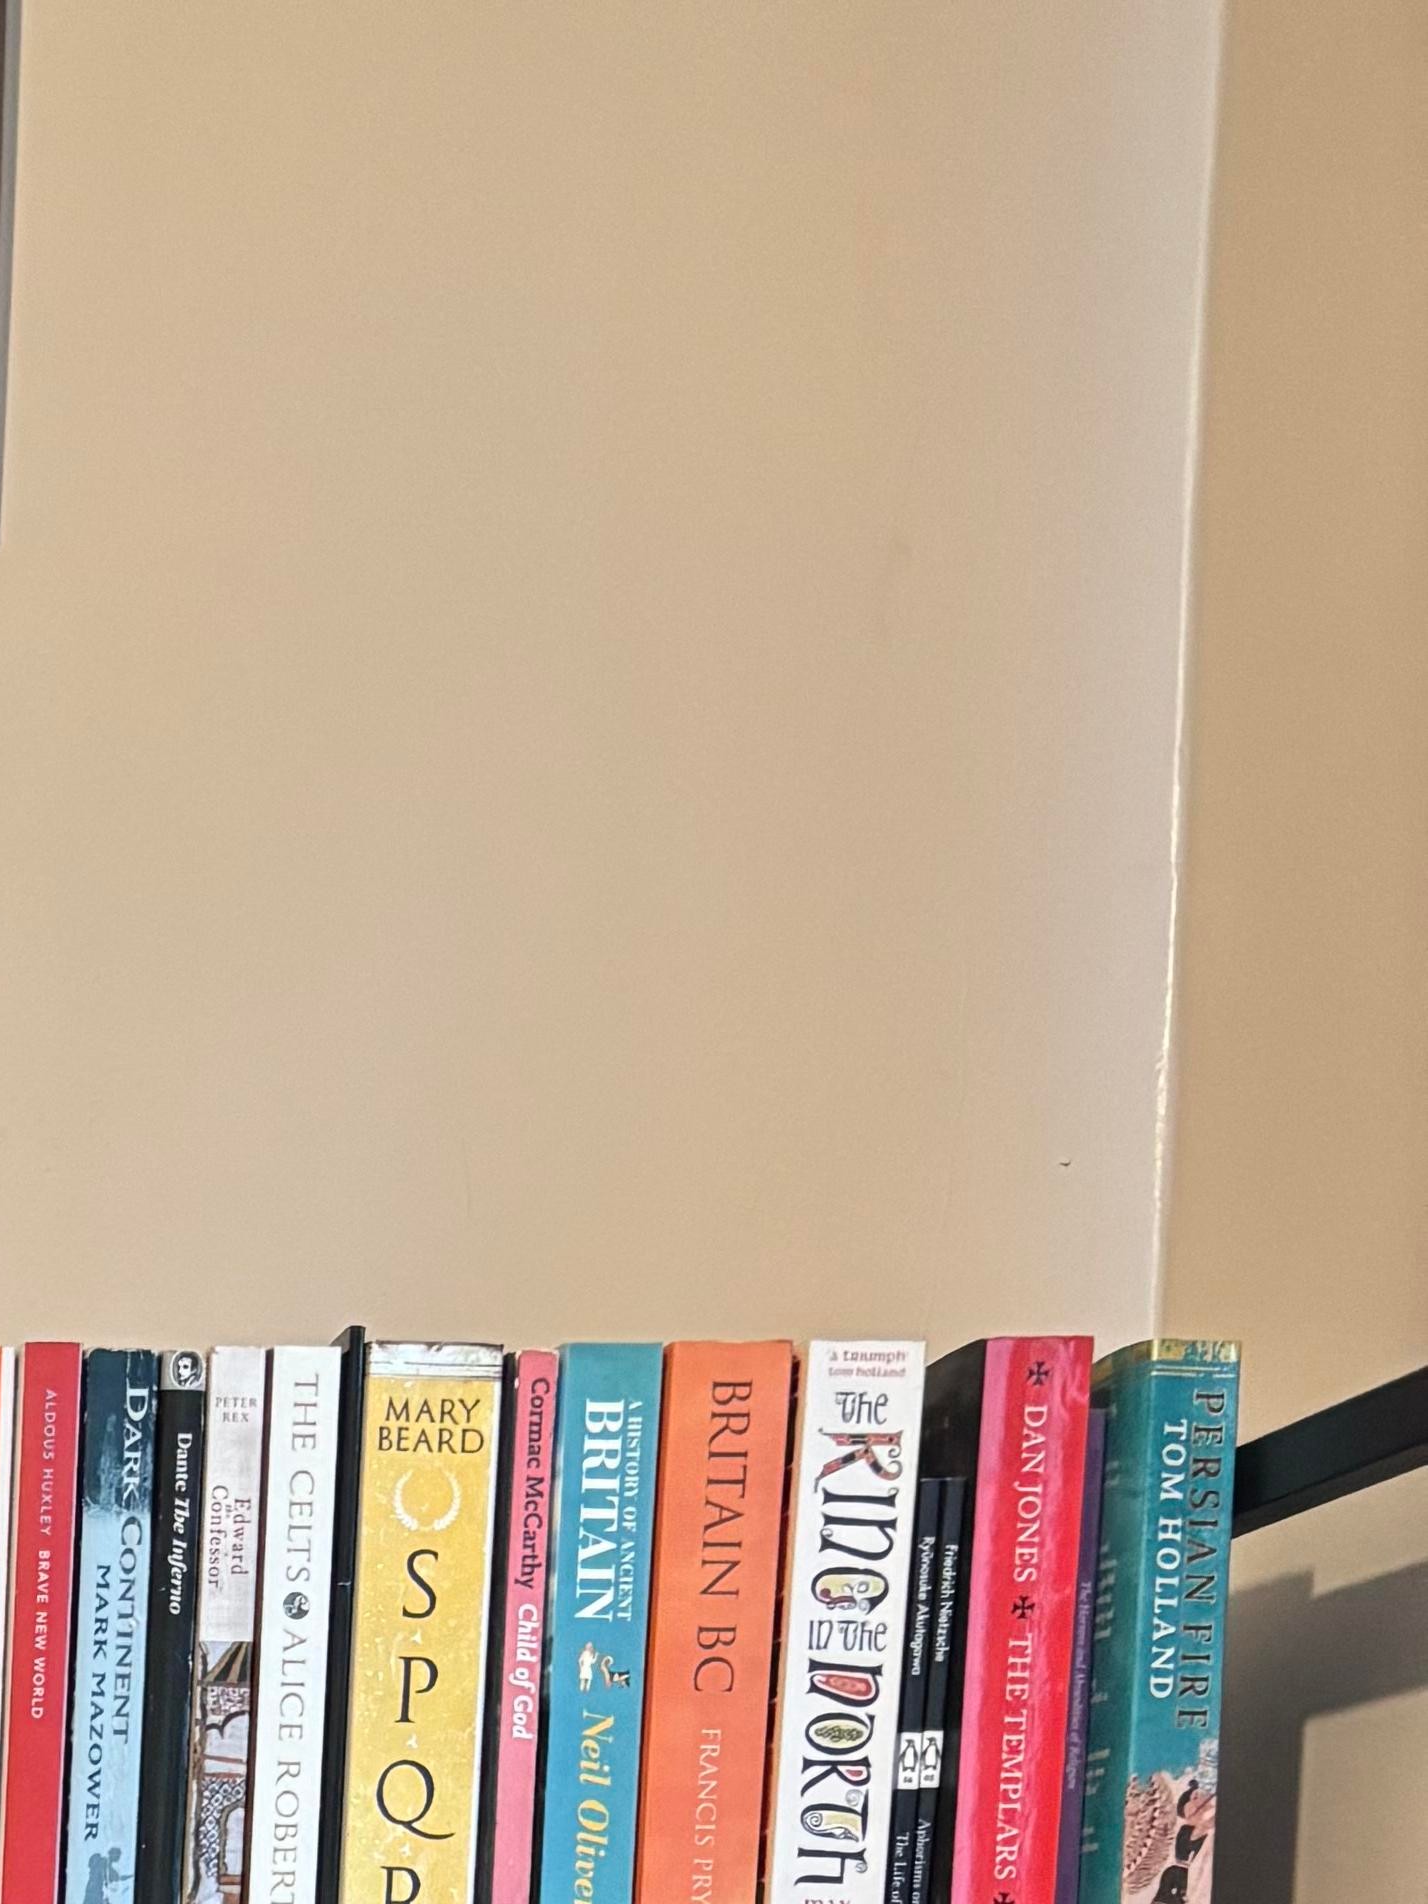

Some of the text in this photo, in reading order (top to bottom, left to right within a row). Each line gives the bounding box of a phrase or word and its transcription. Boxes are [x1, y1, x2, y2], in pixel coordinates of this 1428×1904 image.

[378, 1427, 484, 1453] BEARD
[385, 1398, 480, 1424] MARY
[1149, 1420, 1188, 1700] TOM HOLLAND
[31, 1550, 51, 1719] BRAVE NEW WORLD
[583, 1712, 614, 1790] Neil
